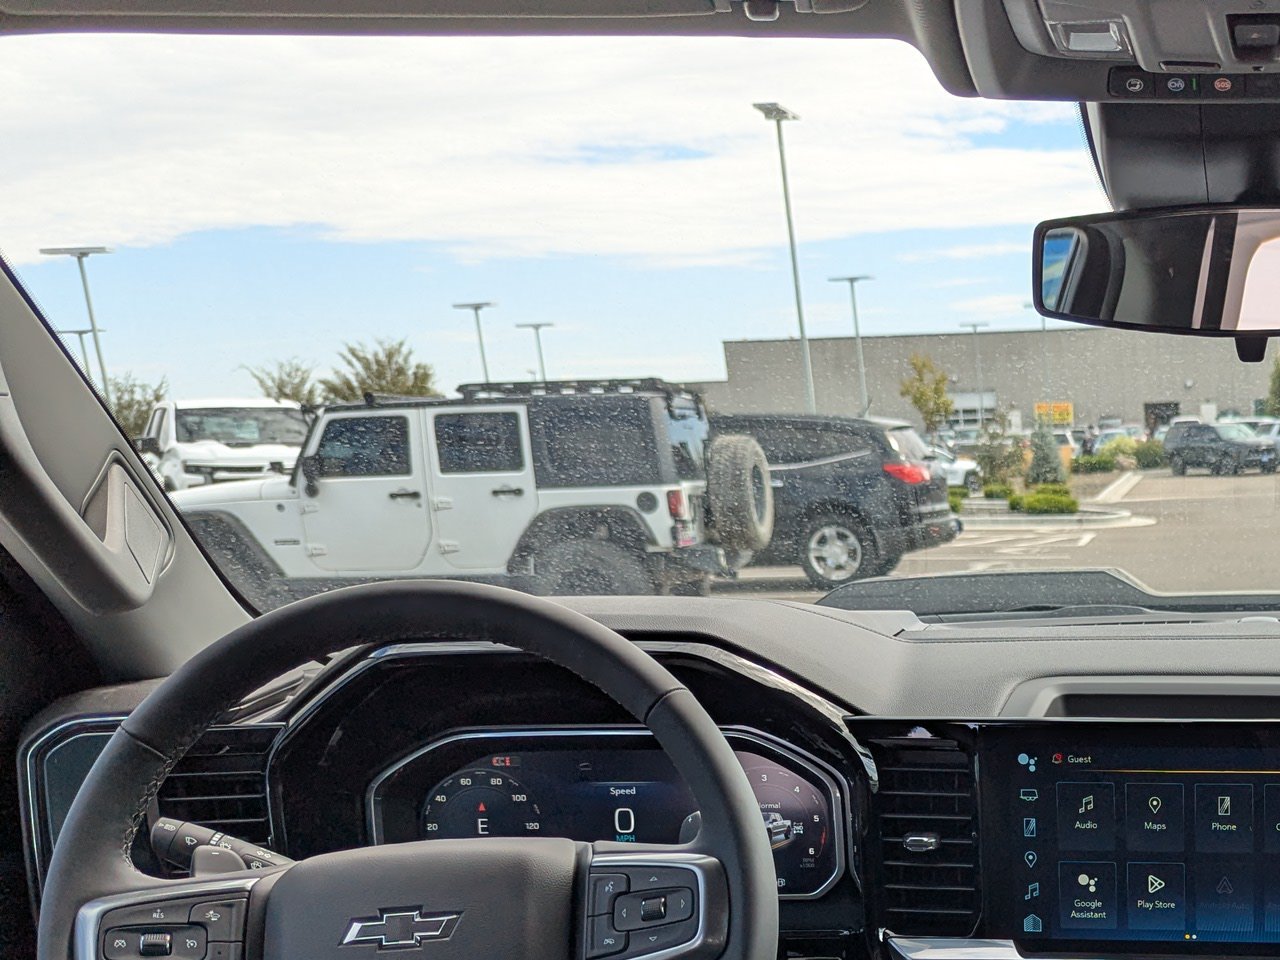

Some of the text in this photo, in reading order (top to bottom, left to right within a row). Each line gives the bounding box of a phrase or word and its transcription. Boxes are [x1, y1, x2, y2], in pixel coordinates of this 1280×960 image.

[1068, 755, 1091, 764] Guest
[460, 778, 472, 786] 60
[490, 778, 502, 786] 80
[762, 774, 767, 782] 3
[610, 786, 636, 796] Speed
[512, 794, 526, 802] 100
[614, 808, 635, 833] 0
[1074, 820, 1097, 829] Audio
[478, 818, 489, 834] E
[1144, 822, 1166, 831] Maps
[1212, 822, 1236, 831] Phone
[616, 834, 636, 842] MPH
[1074, 899, 1102, 909] Google
[1137, 900, 1176, 910] Play Store
[1070, 910, 1106, 919] Assistant
